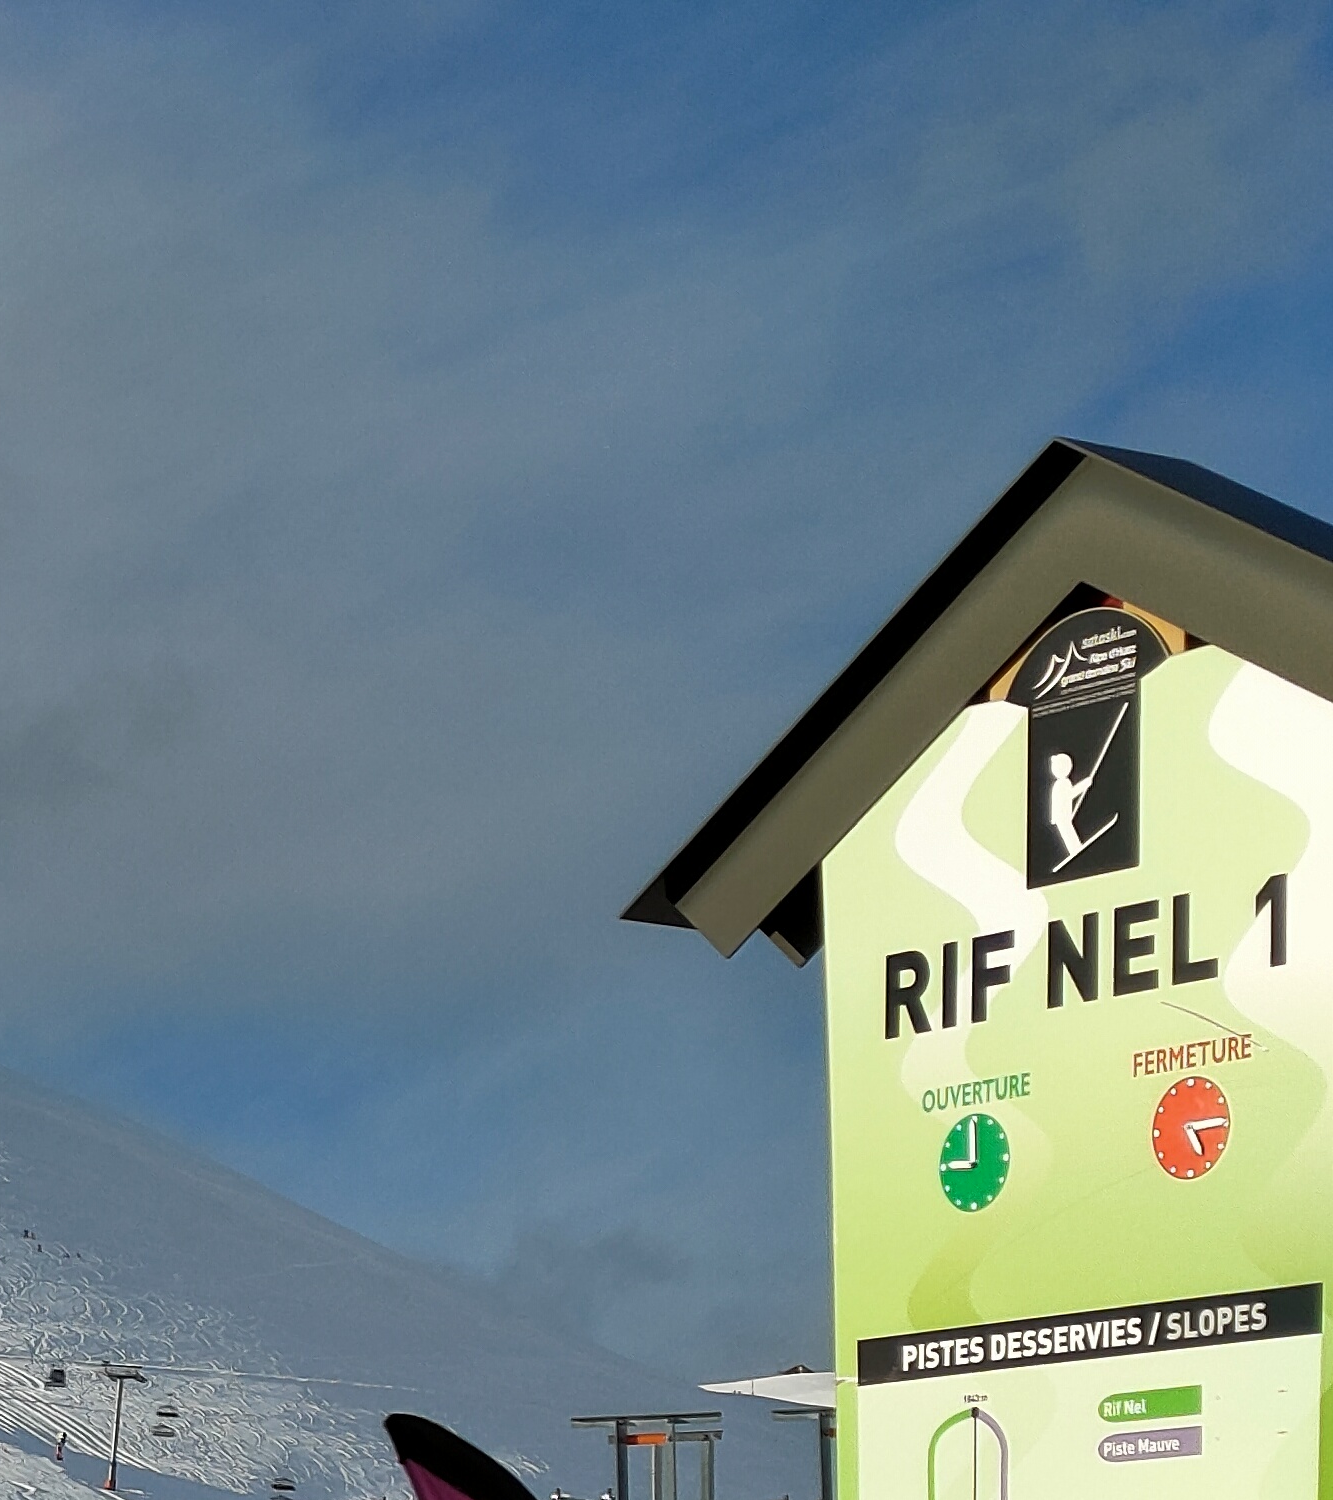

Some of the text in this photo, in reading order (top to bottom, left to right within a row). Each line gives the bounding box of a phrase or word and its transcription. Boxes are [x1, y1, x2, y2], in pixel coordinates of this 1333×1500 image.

[885, 873, 1287, 1040] RIF NEL 1
[1132, 1033, 1252, 1078] FERMETURE
[921, 1072, 1031, 1114] OUVERTURE
[901, 1302, 1268, 1372] PISTES DESSERVIES / SLOPES
[1103, 1398, 1147, 1417] Rif Nel
[1103, 1438, 1180, 1457] Piste Mauve
